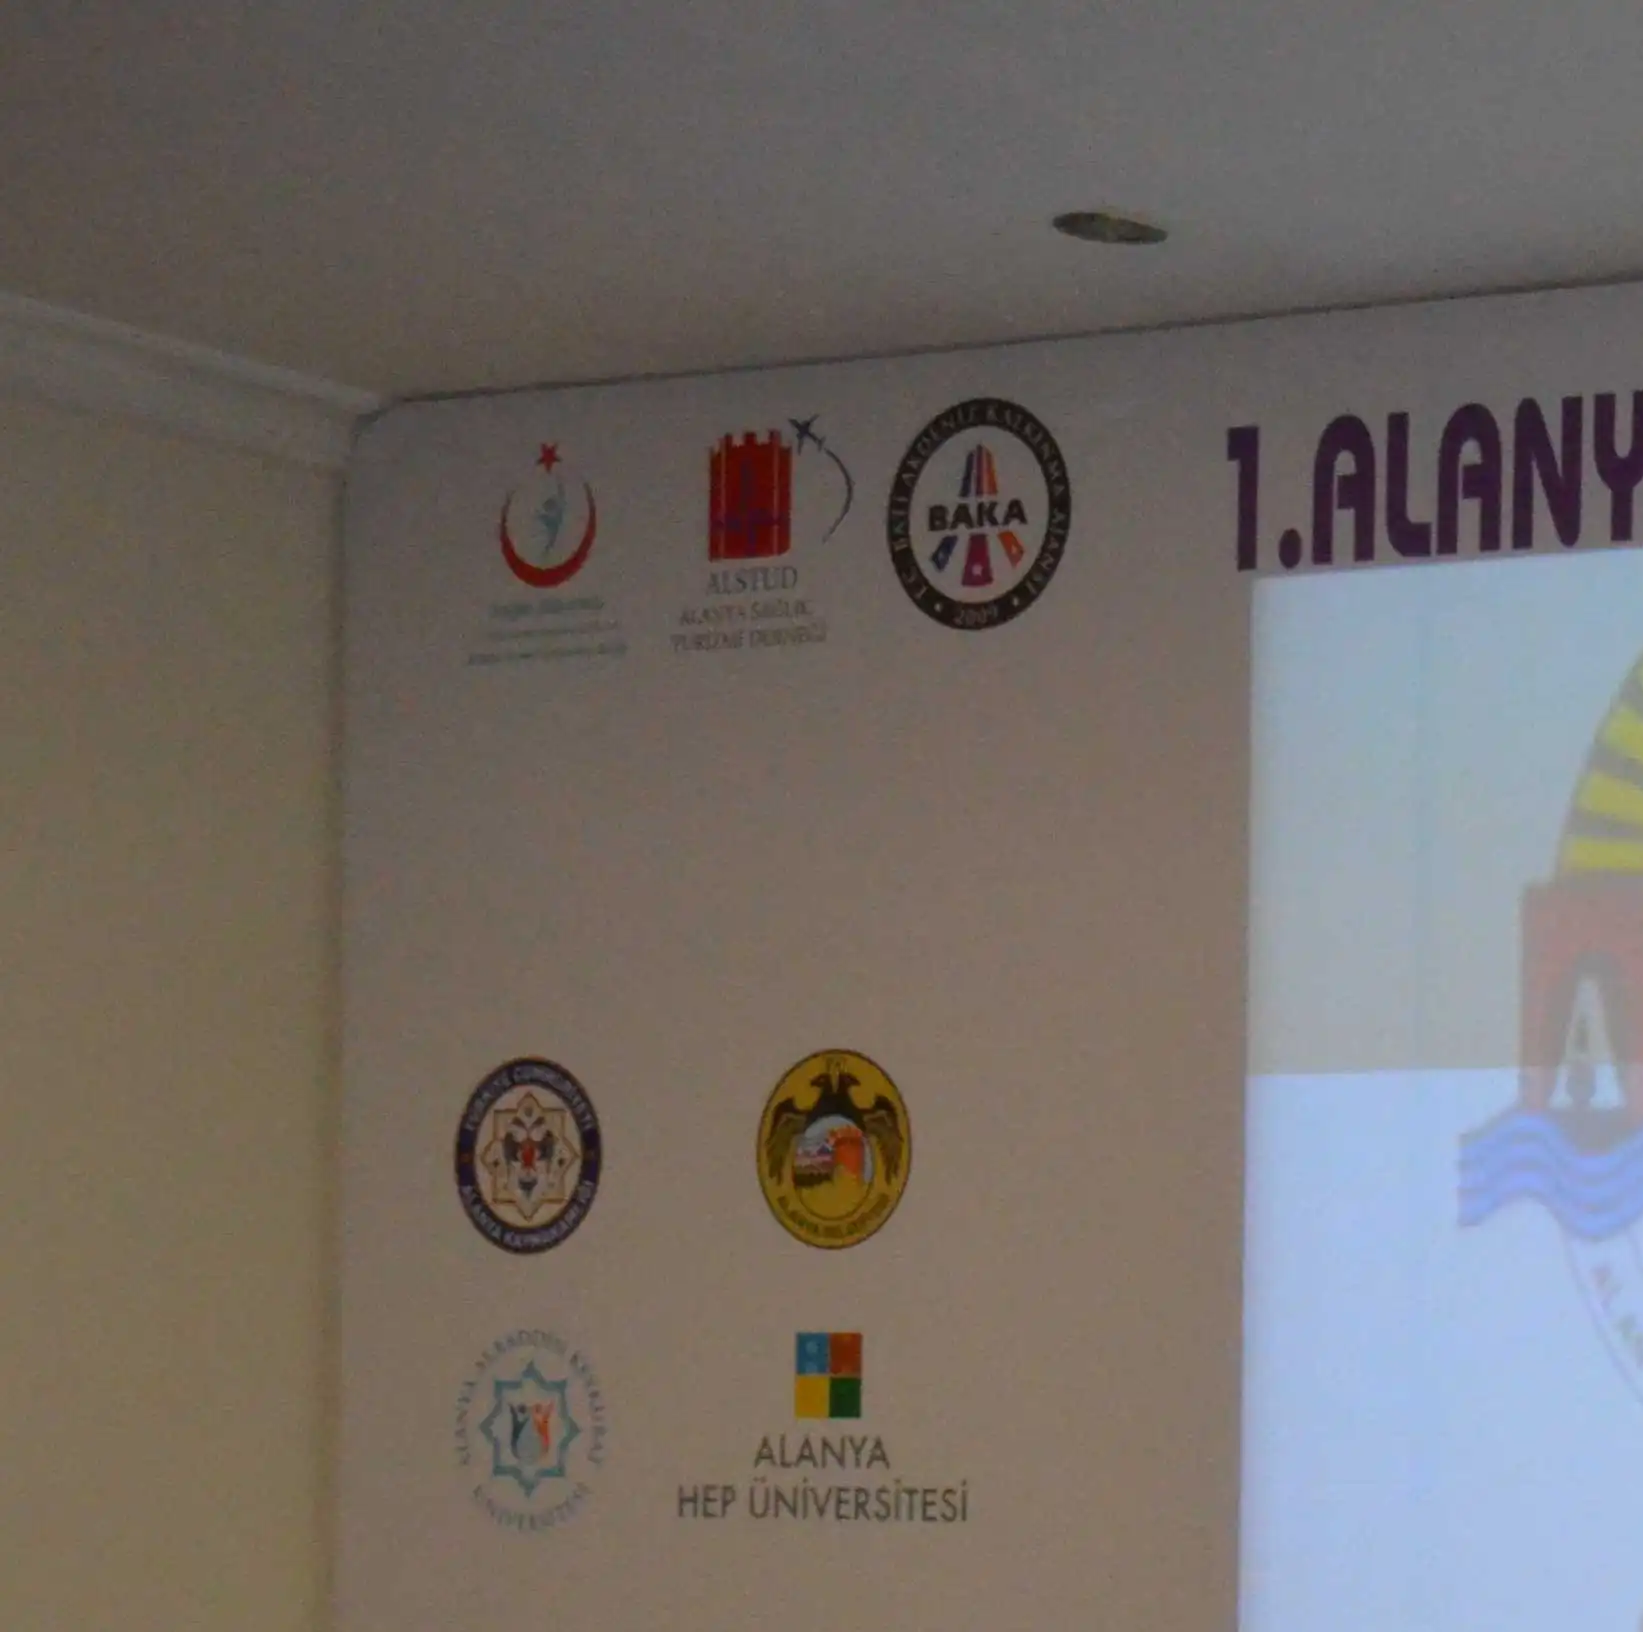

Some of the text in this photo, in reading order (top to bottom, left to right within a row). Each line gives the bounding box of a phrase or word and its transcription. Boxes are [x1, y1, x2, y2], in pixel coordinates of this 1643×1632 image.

[927, 497, 1028, 532] BAKA
[707, 565, 798, 595] ALSTUD
[753, 1433, 891, 1470] ALANYA
[677, 1476, 970, 1523] HEP ÜNİVERSİTESİ
